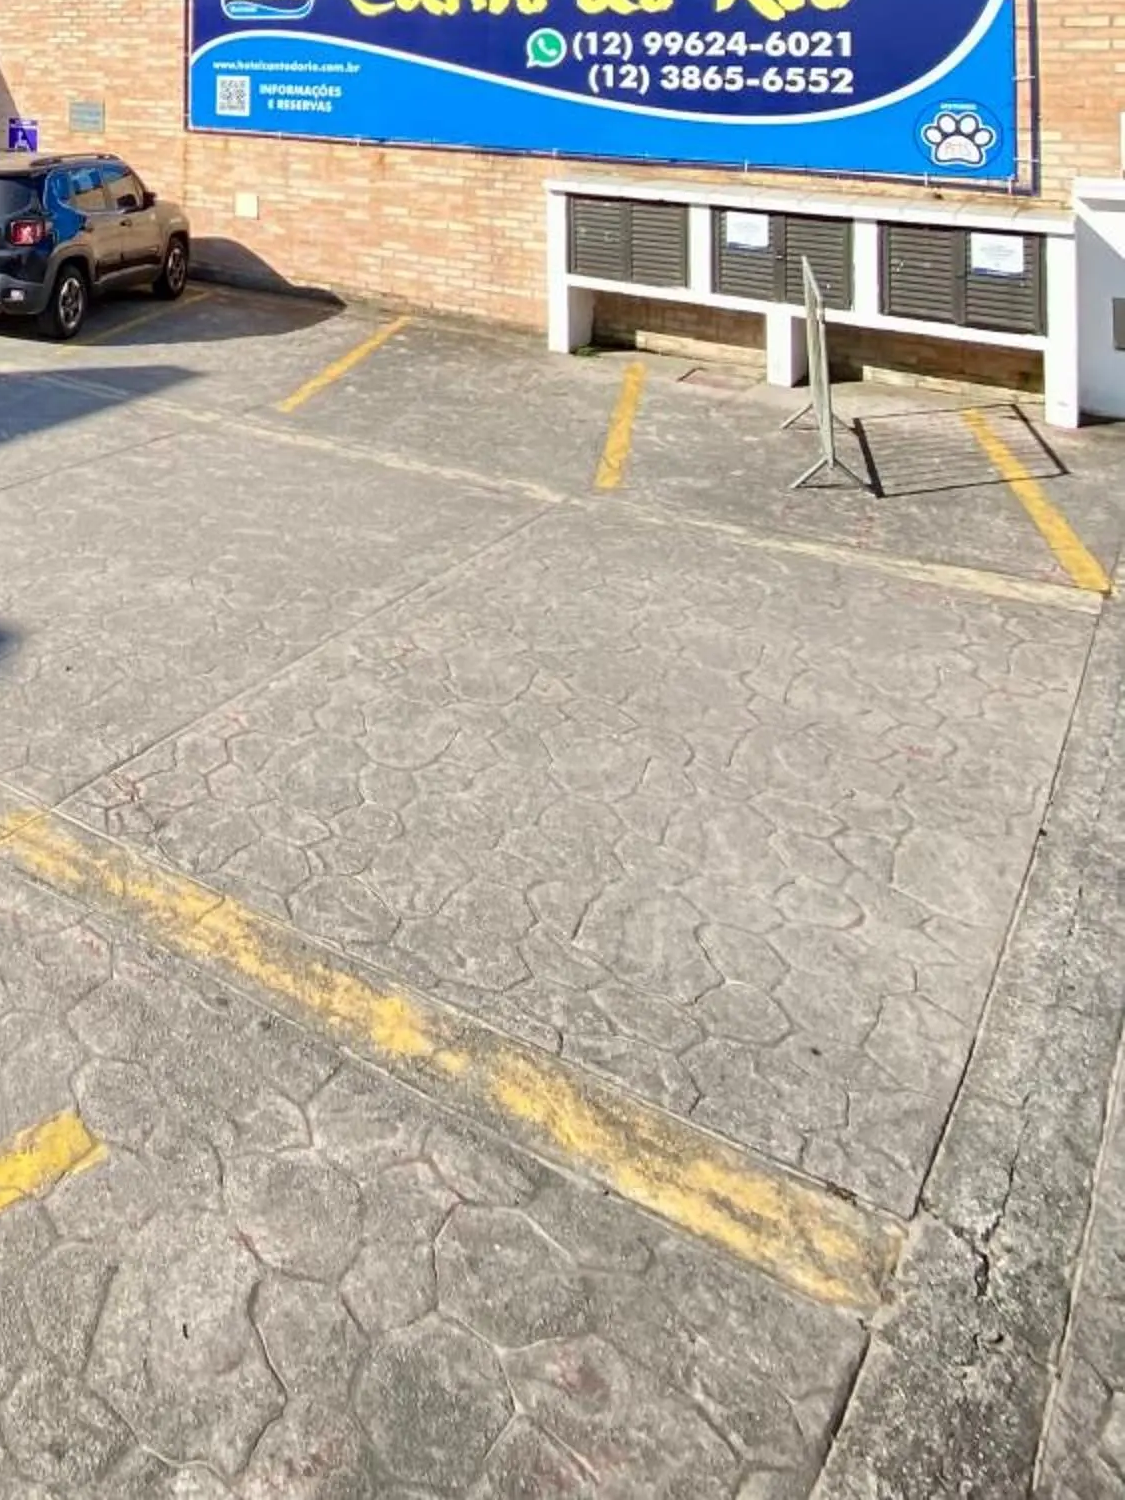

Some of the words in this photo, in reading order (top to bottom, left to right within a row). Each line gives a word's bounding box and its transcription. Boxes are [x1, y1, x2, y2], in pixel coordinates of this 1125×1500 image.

[573, 31, 632, 61] (12)
[642, 31, 853, 57] 99624-6021
[259, 82, 342, 98] INFORMAÇÕES
[588, 64, 650, 95] (12)
[660, 65, 854, 94] 3865-6552
[277, 99, 332, 113] RESERVAS
